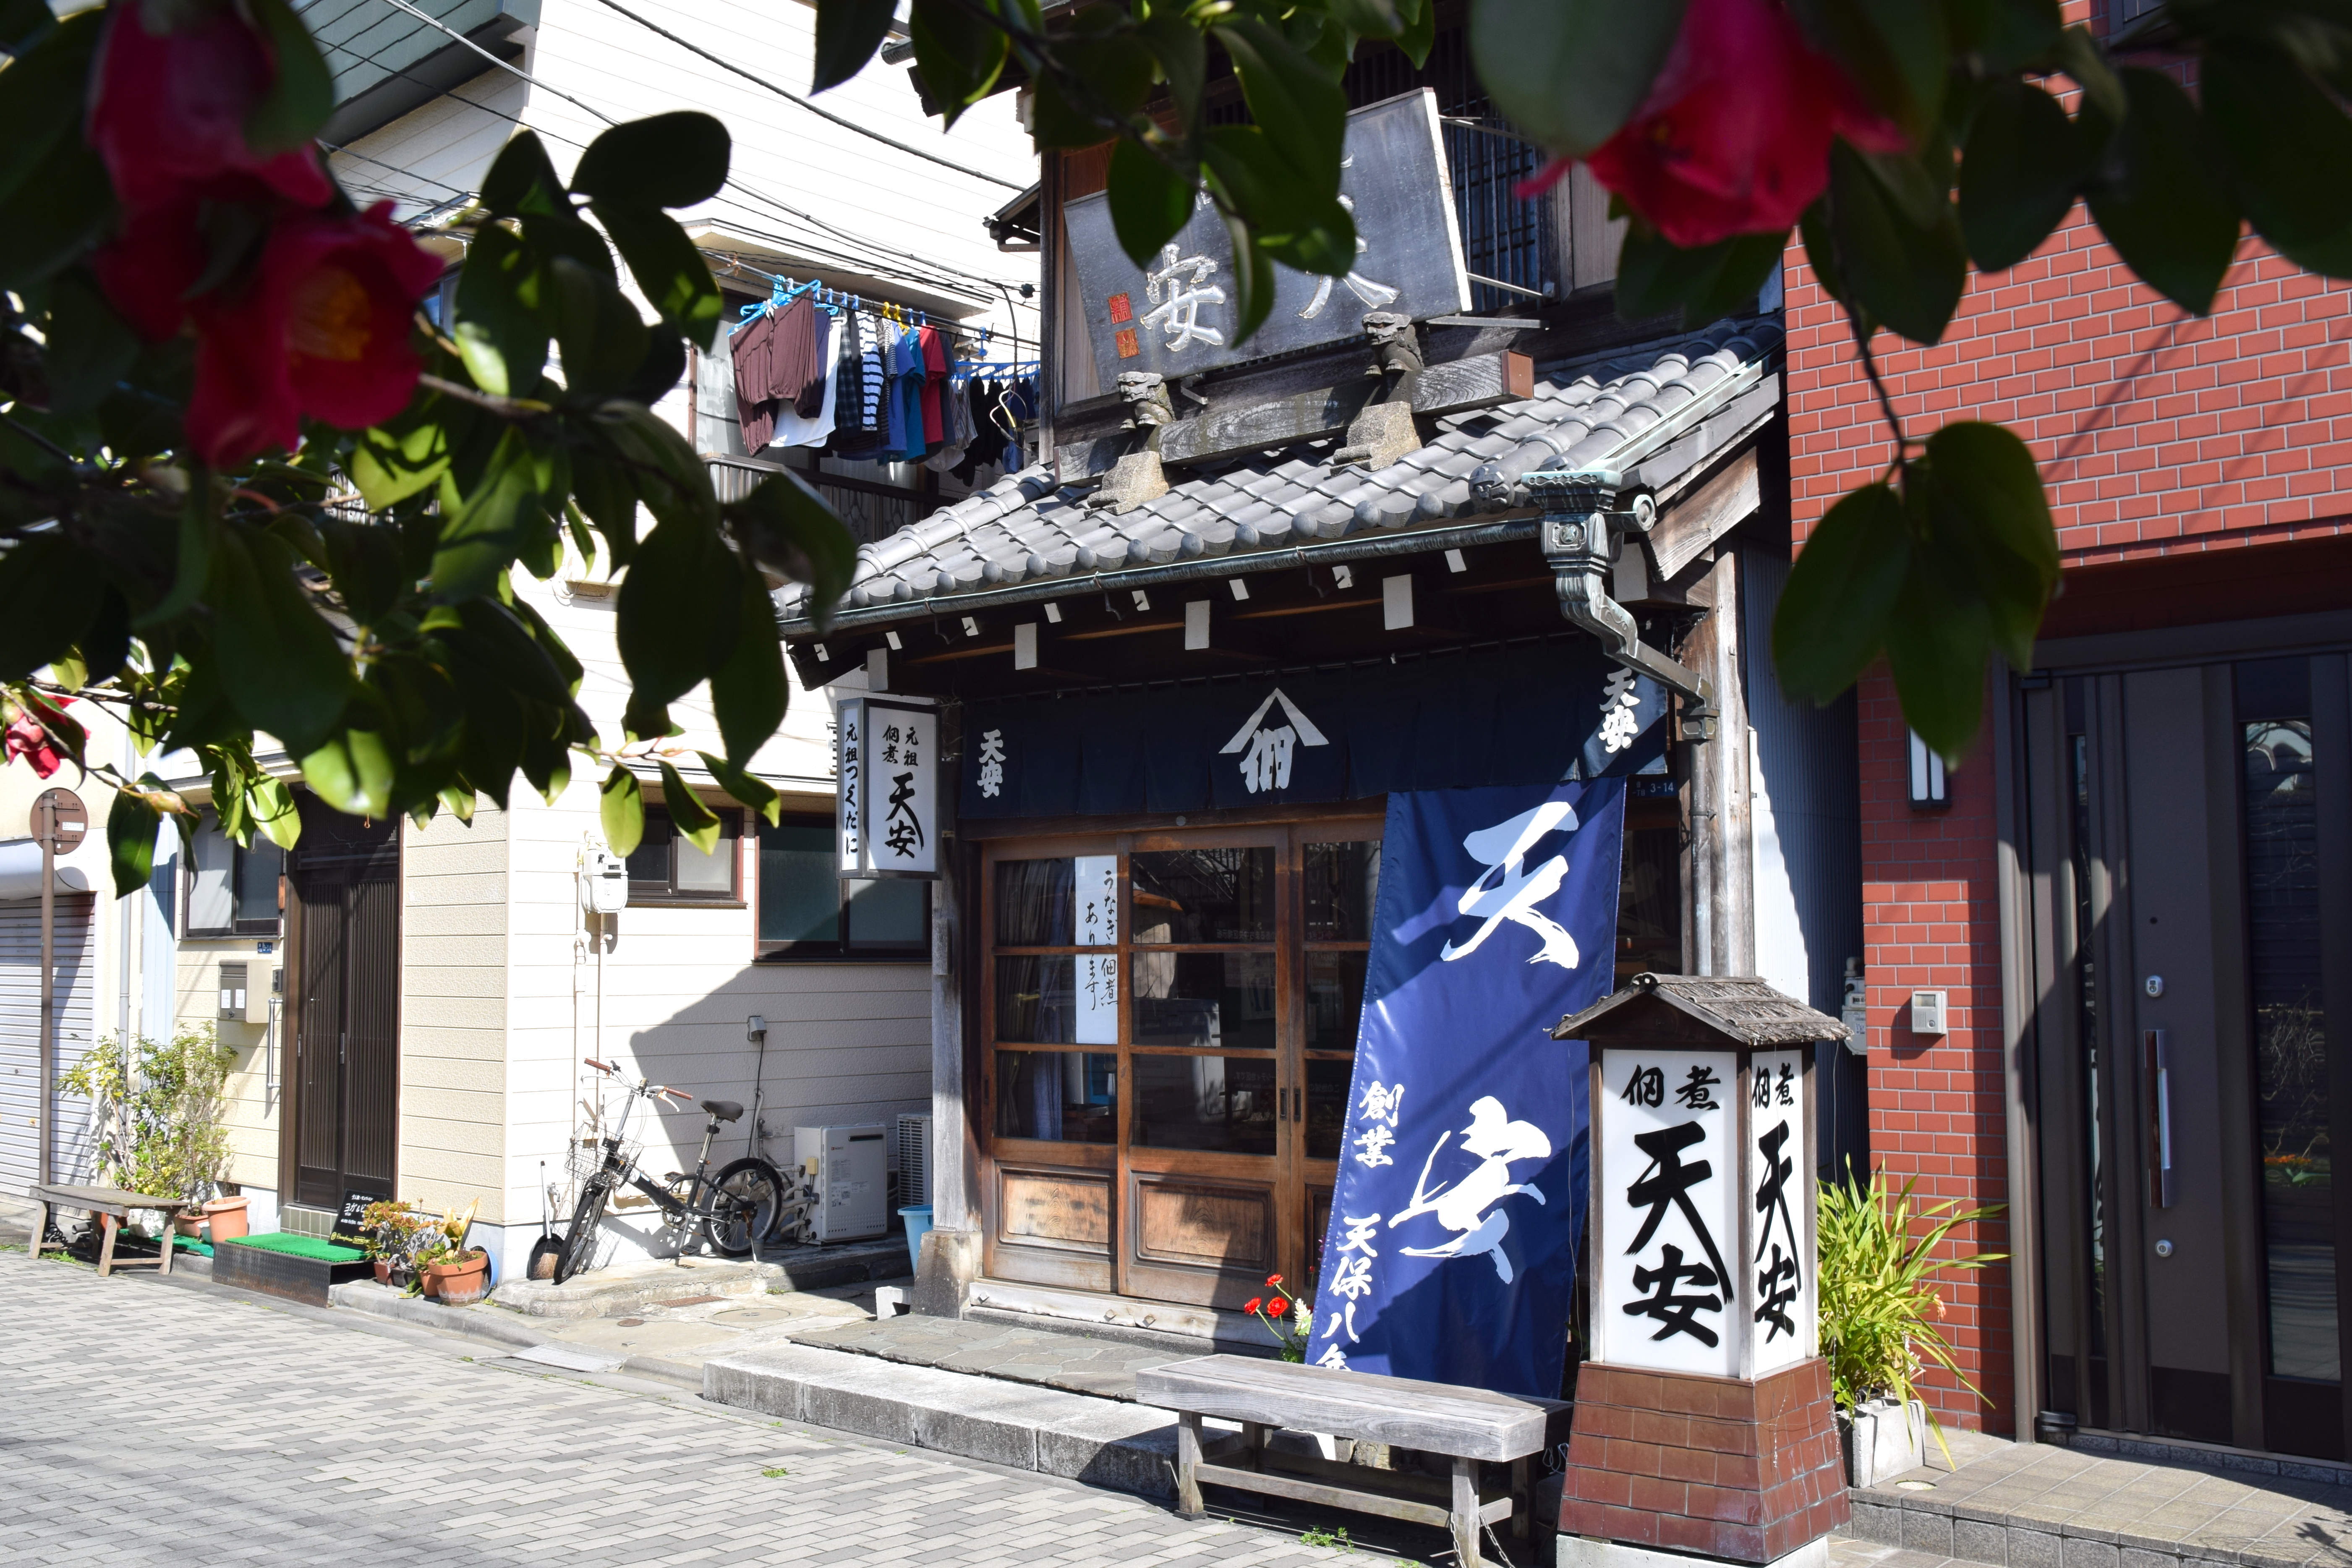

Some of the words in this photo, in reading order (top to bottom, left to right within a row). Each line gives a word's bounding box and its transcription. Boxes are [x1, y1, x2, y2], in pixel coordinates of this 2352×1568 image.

[882, 724, 899, 764] 佃煮
[903, 726, 919, 767] 元祖
[977, 729, 1006, 798] 天安
[1650, 781, 1674, 793] 3-14
[845, 723, 858, 855] 元祖つくだに
[885, 771, 924, 859] 天安
[1101, 870, 1118, 1005] うなぎ佃煮
[1388, 801, 1580, 1285] 天安
[1753, 1062, 1794, 1109] 佃煮
[1354, 1080, 1405, 1168] 創業
[1619, 1064, 1721, 1111] 佃煮
[1622, 1121, 1734, 1348] 天安
[1754, 1119, 1802, 1344] 天安
